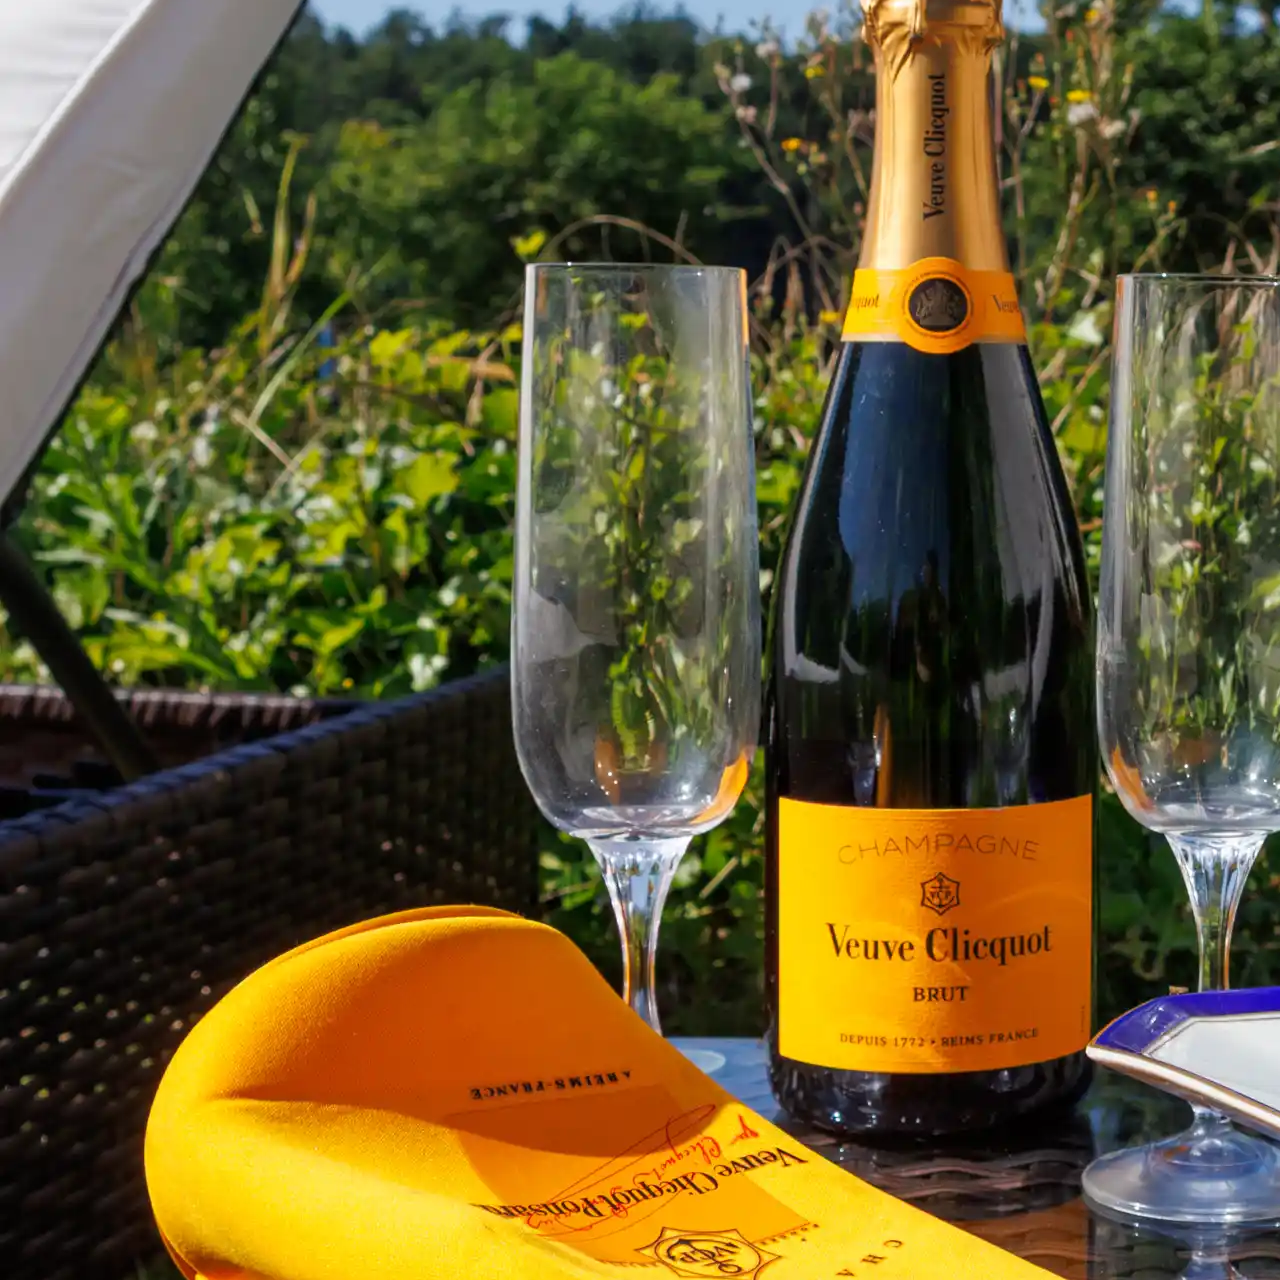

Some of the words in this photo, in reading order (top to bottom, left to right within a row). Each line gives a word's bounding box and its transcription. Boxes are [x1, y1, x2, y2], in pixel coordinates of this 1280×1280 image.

[922, 72, 949, 160] Clicquot
[922, 163, 946, 221] Veuve
[838, 833, 1040, 865] CHAMPAGNE
[825, 922, 915, 962] Veuve
[925, 924, 1053, 966] Clicquot
[912, 985, 970, 1002] BRUT
[839, 1032, 888, 1047] DEPUIS
[892, 1036, 926, 1048] 1772
[941, 1034, 985, 1048] REIMS
[988, 1027, 1039, 1043] FRANCE
[712, 1147, 809, 1180] Veuve
[599, 1170, 719, 1214] Clicquot
